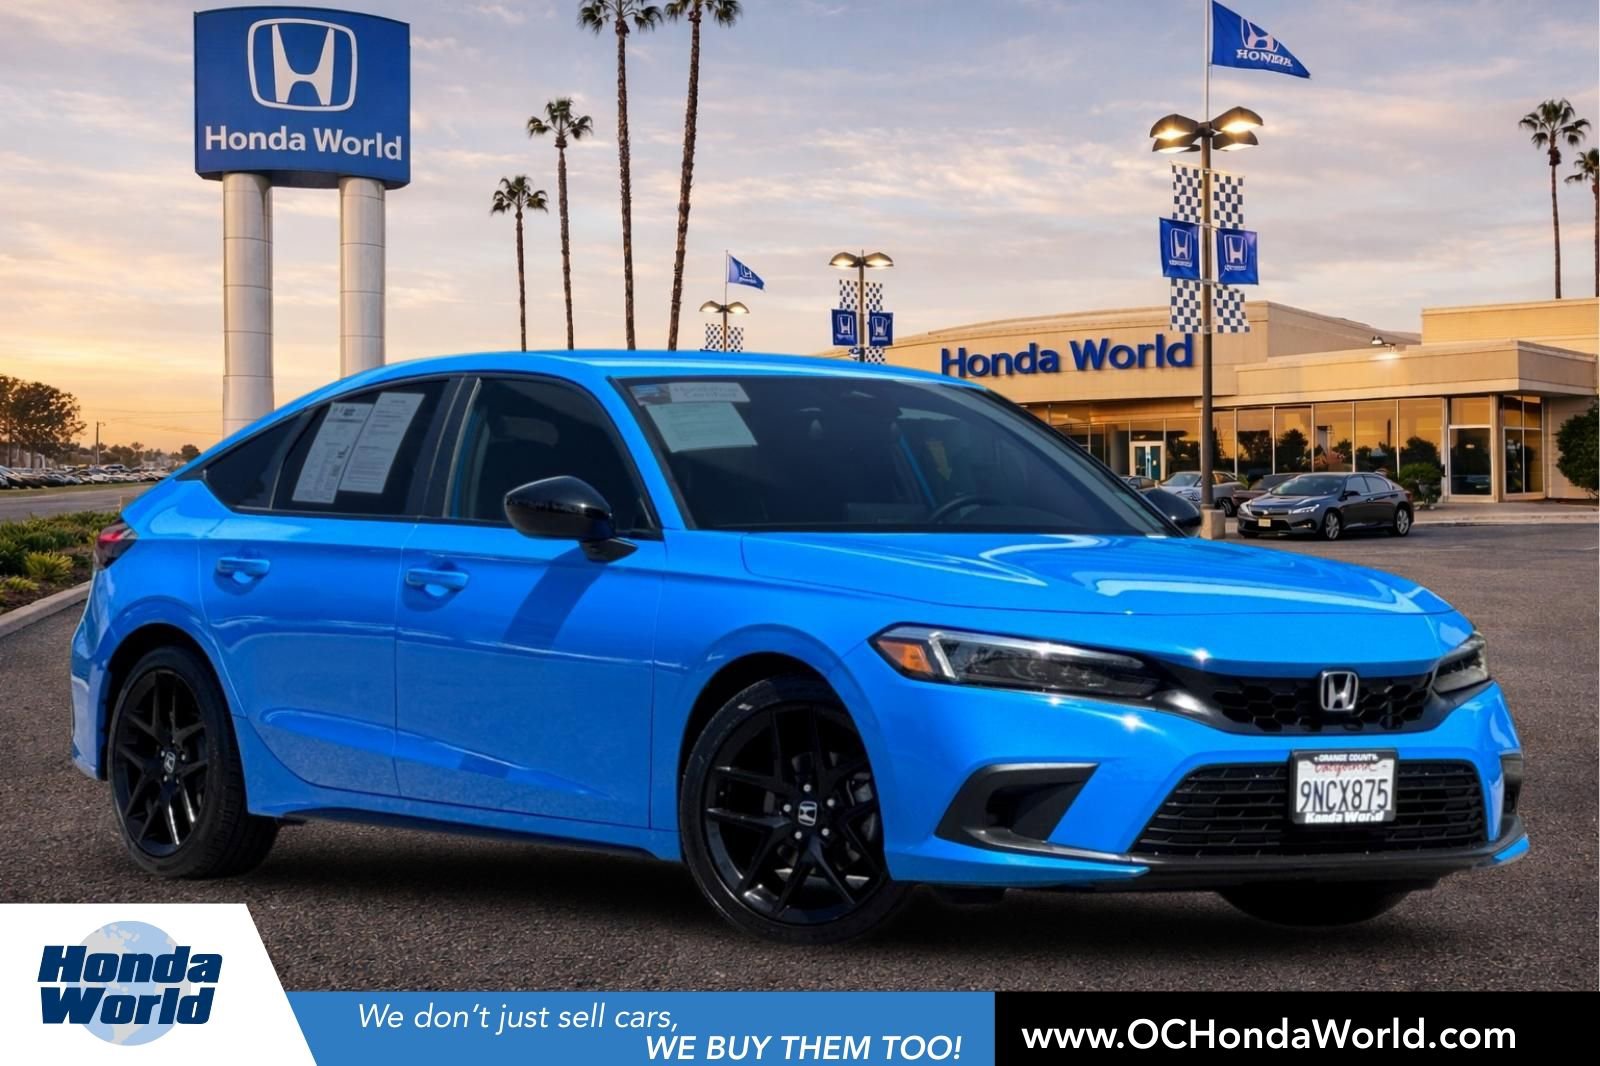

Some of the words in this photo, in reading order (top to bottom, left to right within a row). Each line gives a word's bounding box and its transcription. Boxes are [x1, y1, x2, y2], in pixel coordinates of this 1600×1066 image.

[205, 125, 306, 151] Honda
[313, 127, 402, 161] World
[941, 342, 1061, 378] Honda
[1069, 333, 1195, 371] World
[1300, 779, 1389, 812] 9NCX875
